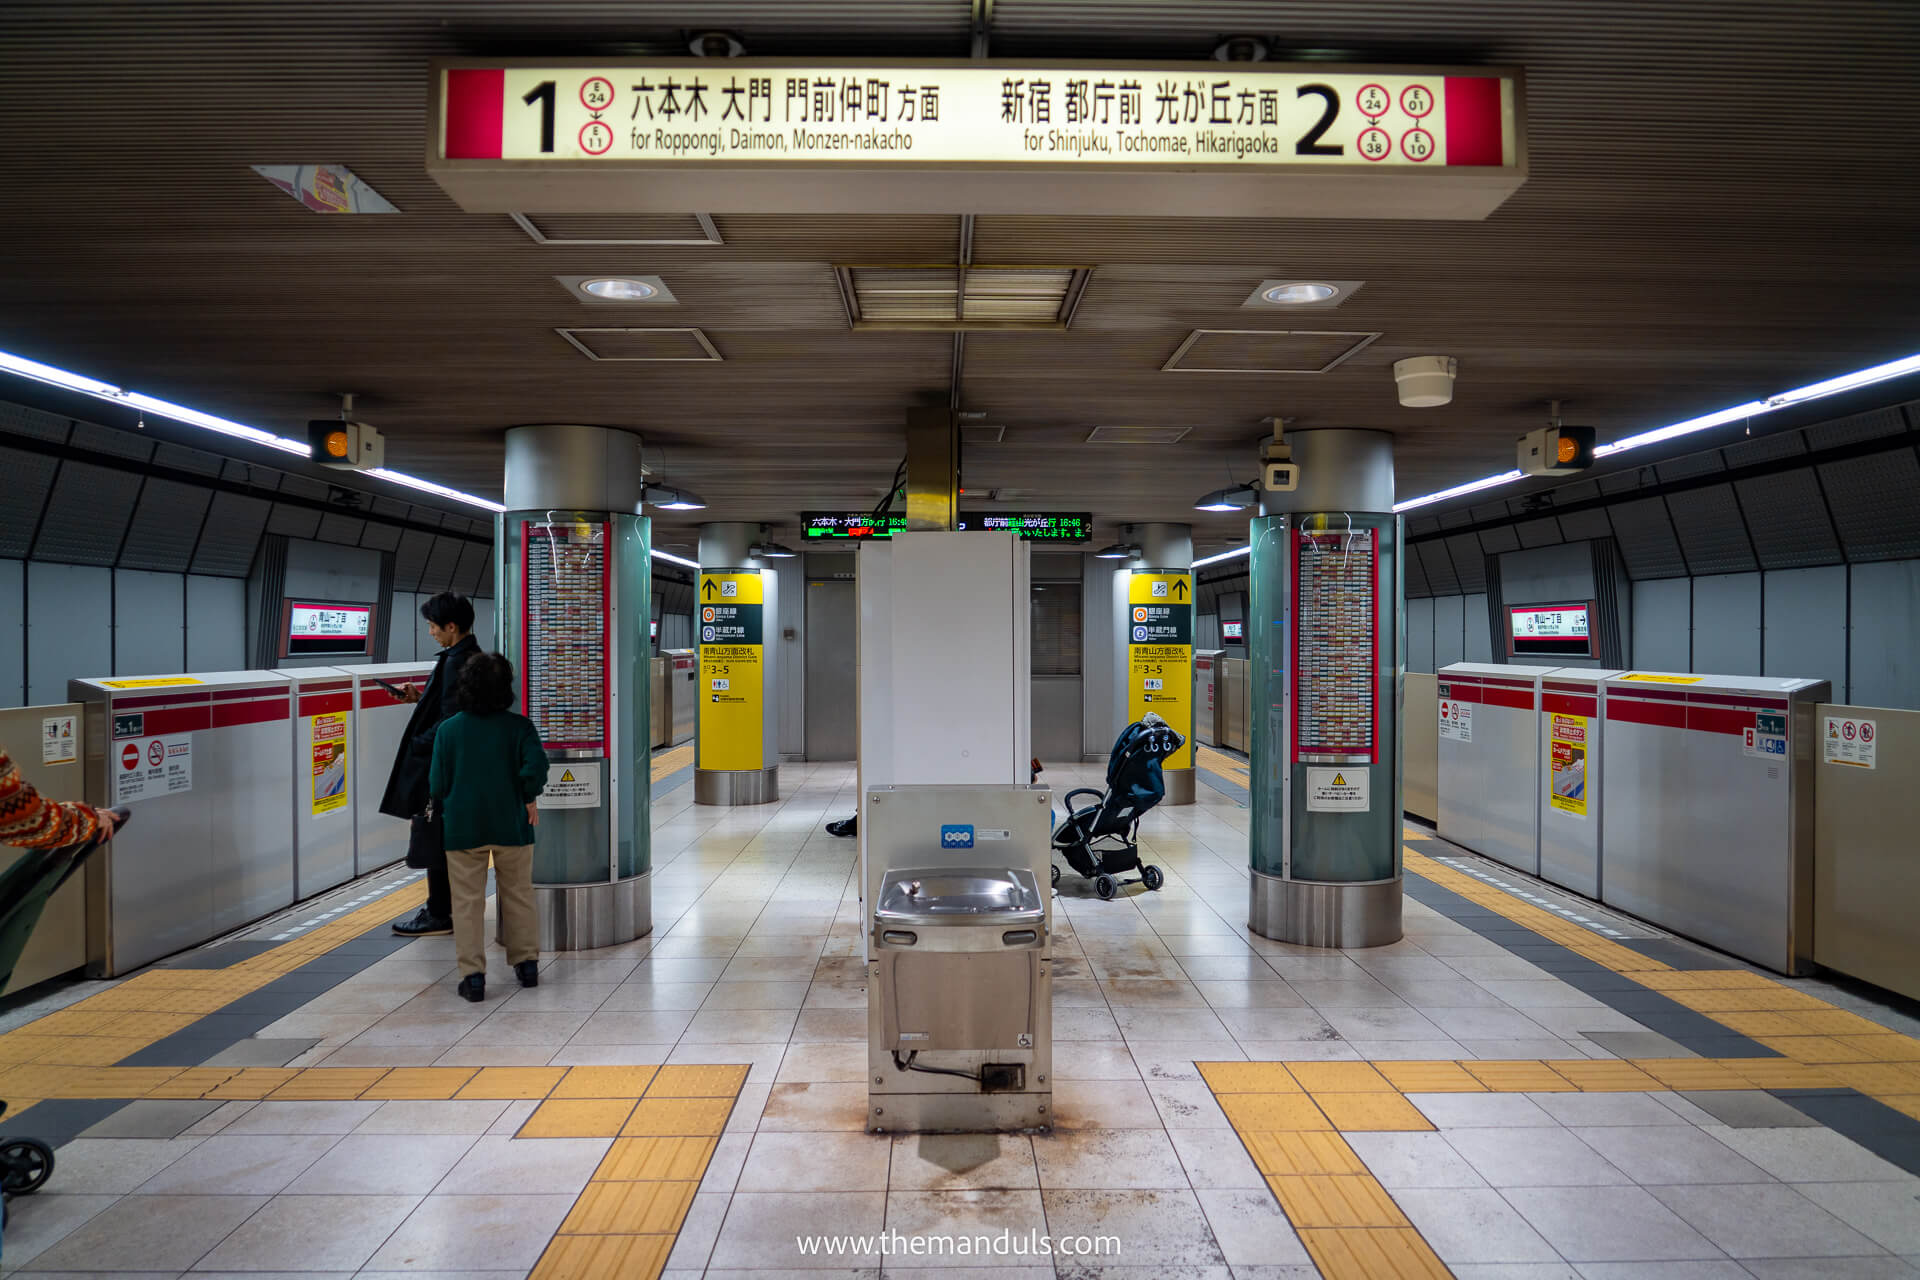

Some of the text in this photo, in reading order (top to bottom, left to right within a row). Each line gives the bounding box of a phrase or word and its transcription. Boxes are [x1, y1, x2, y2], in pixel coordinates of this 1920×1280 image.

[594, 82, 600, 92] E
[589, 93, 604, 103] 24
[1370, 89, 1376, 98] E
[1414, 90, 1420, 99] E
[631, 76, 939, 122] 六本木 大門 門前仲町 方面
[1001, 77, 1278, 126] 新宿 都庁前 光が丘 方面
[1366, 100, 1381, 110] 24
[1409, 100, 1424, 111] 01
[522, 80, 556, 152] 1
[1295, 82, 1344, 156] 2
[593, 127, 599, 136] E
[631, 127, 913, 155] for Roppongi, Daimon, Monzen-nakacho
[1371, 132, 1377, 142] E
[1414, 133, 1420, 143] E
[588, 137, 602, 148] 11
[1024, 128, 1278, 159] for Shinjuku, Tochomae, Hikarigaoka
[1367, 143, 1382, 154] 38
[1411, 144, 1426, 154] 10
[1060, 518, 1080, 527] 16:46
[1085, 523, 1091, 532] 2
